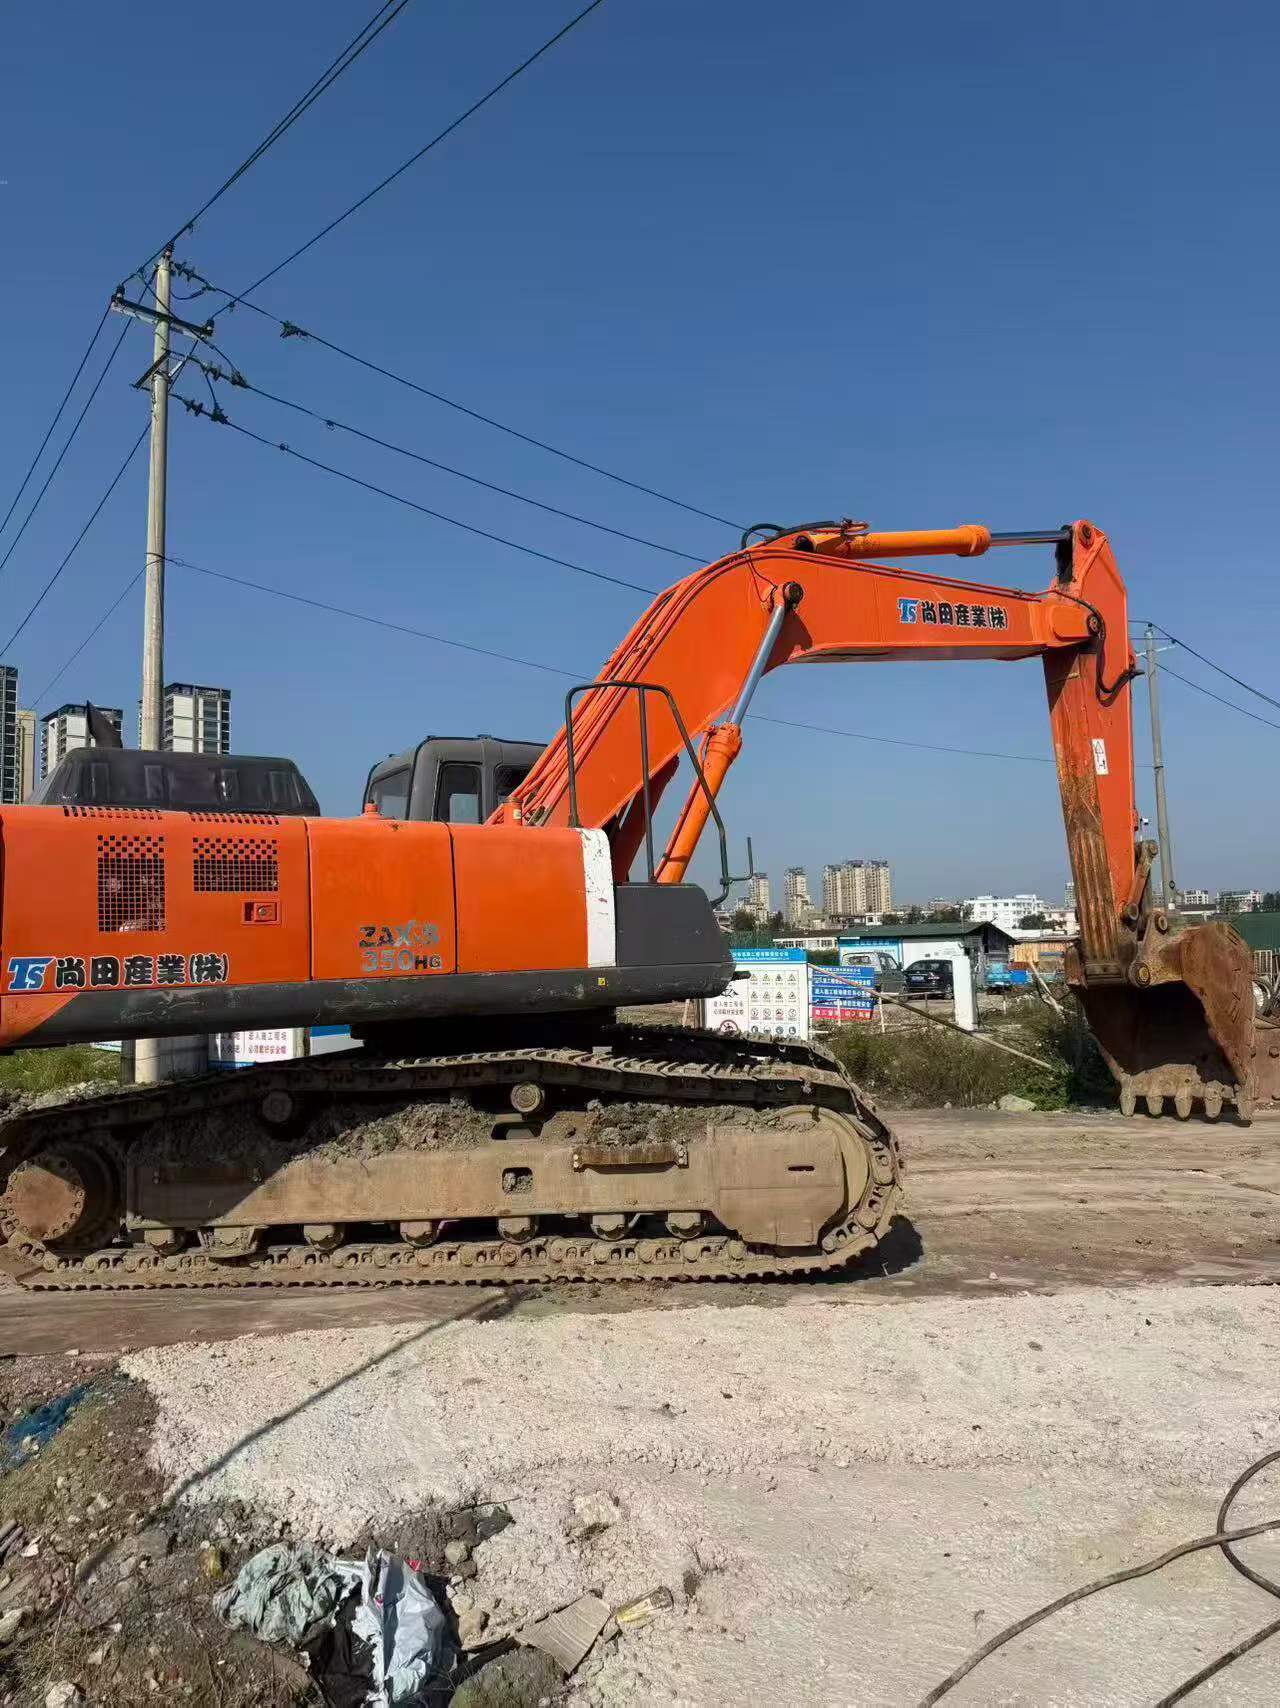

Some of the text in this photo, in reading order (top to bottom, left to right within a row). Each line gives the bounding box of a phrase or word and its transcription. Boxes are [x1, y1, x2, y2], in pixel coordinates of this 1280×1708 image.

[55, 952, 229, 988] 尚田産業(株)
